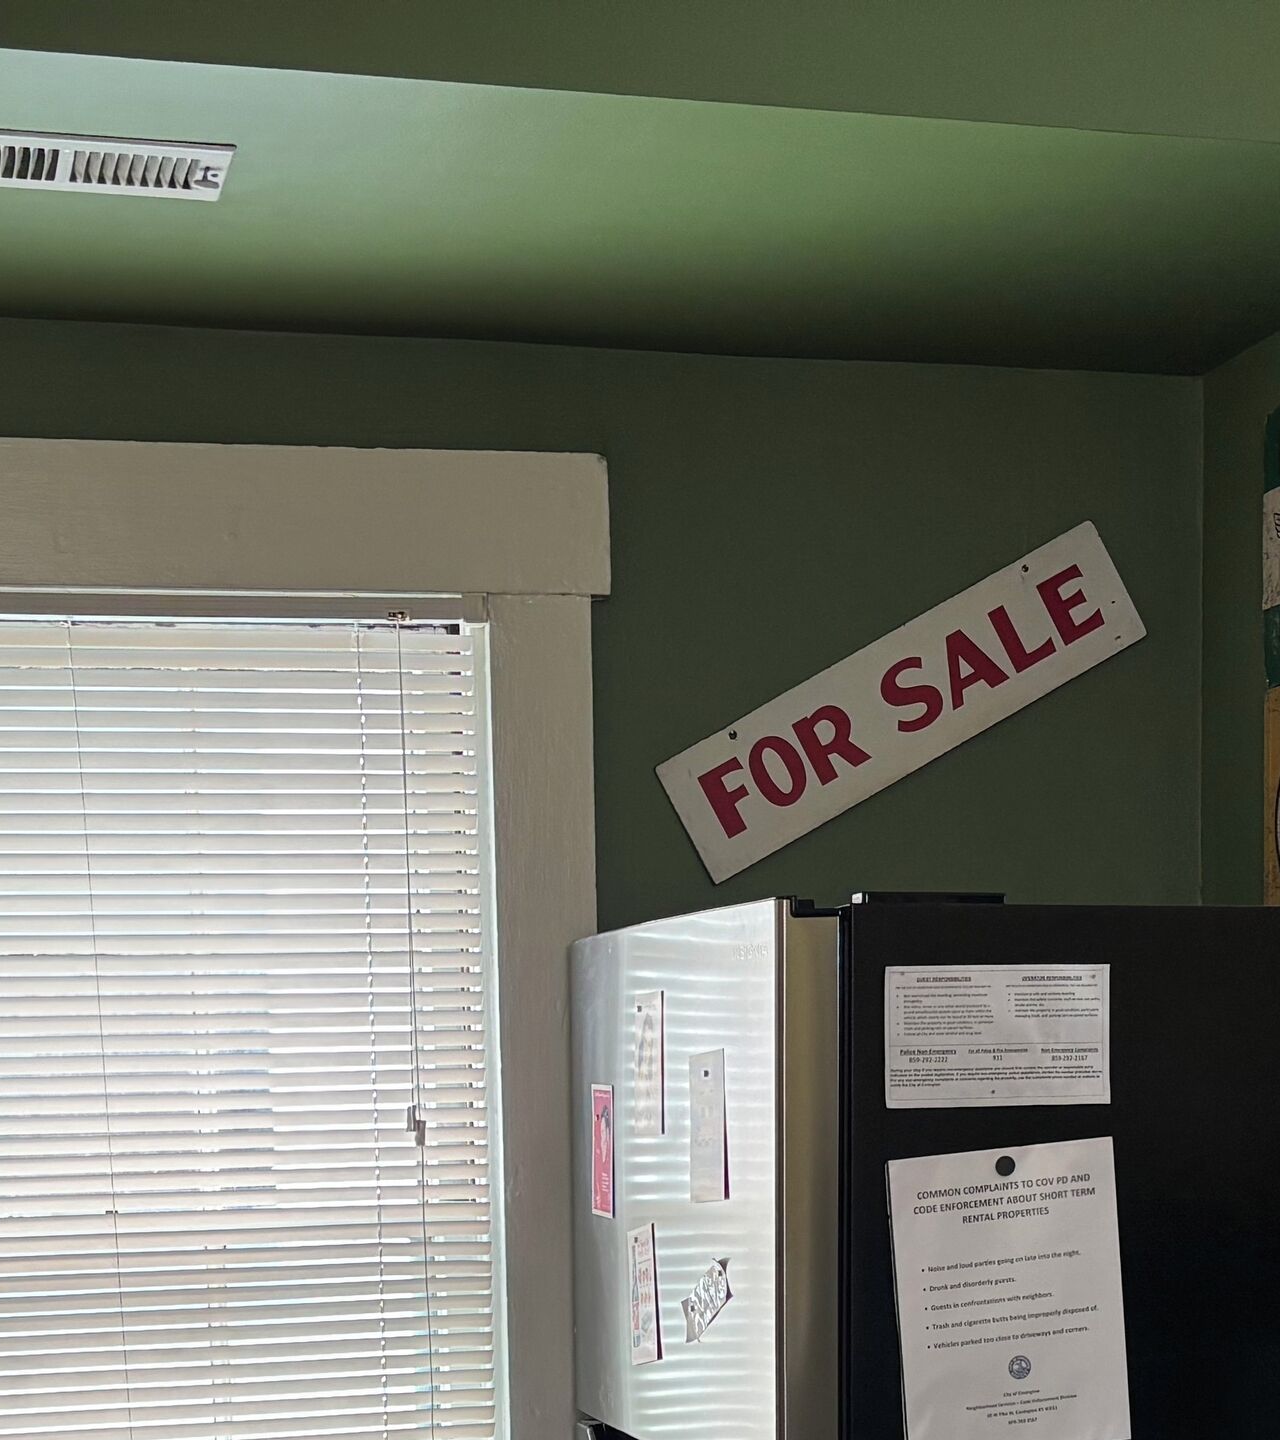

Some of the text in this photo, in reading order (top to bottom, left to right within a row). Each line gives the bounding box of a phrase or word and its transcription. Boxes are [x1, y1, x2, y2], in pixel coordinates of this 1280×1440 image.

[697, 564, 1105, 840] FOR SALE
[917, 1173, 1090, 1200] COMMON COMPLAINTS TO COV PD AND
[913, 1187, 1096, 1215] CODE ENFORCEMENT ABOUT SHORT TERM
[962, 1207, 1050, 1224] RENTAL PROPERTIES
[974, 1259, 996, 1268] parties
[997, 1257, 1014, 1266] going
[929, 1284, 948, 1292] Drunk
[963, 1278, 993, 1288] disorderly
[1009, 1313, 1027, 1321] being
[933, 1341, 959, 1349] Vehicles
[961, 1338, 982, 1347] parked
[1020, 1330, 1051, 1340] driveways
